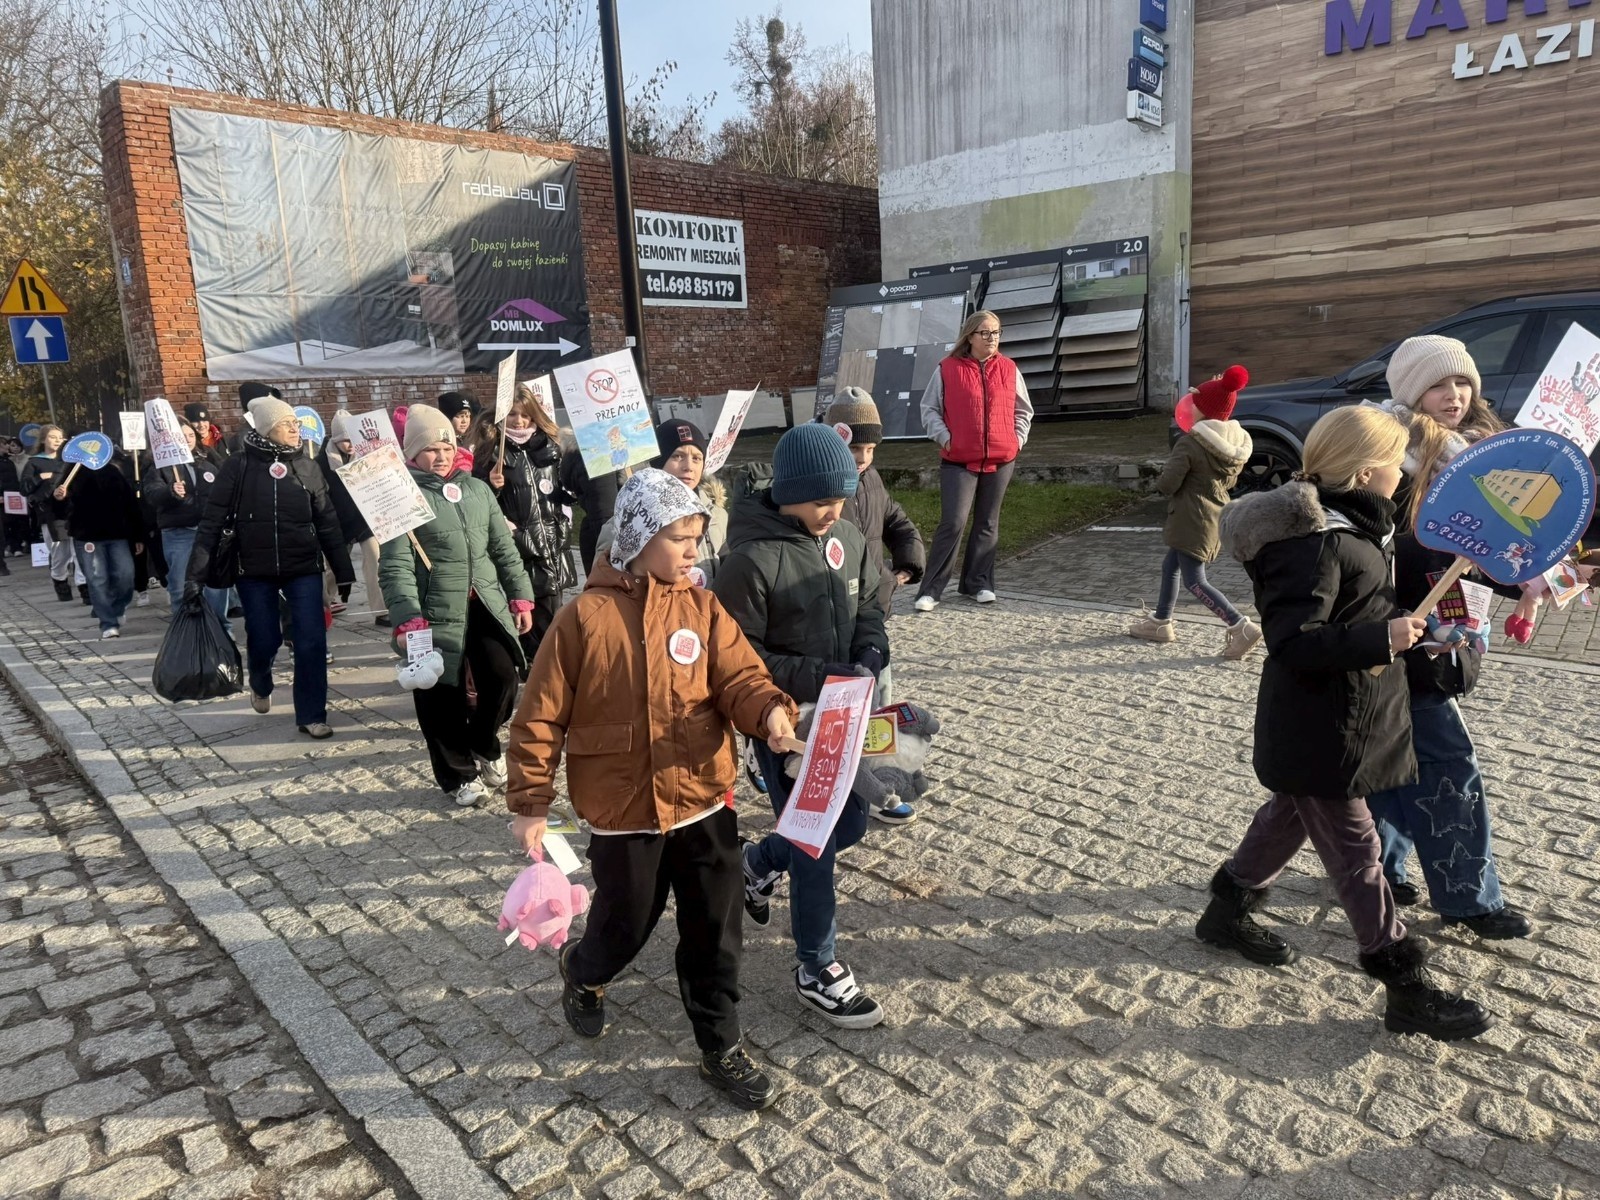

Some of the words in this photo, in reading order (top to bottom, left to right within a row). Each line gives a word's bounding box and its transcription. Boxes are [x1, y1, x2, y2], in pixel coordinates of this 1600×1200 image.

[1142, 35, 1164, 54] GERDA
[1452, 19, 1595, 80] ŁAZI
[462, 176, 541, 209] radaway
[636, 215, 738, 244] KOMFORT
[470, 237, 507, 253] Dopasuj
[510, 238, 540, 251] kabinę
[1123, 240, 1143, 253] 2.0
[492, 254, 503, 268] do
[506, 255, 532, 268] swojej
[535, 252, 568, 266] łazienki
[637, 243, 687, 262] REMONTY
[690, 247, 741, 267] MIESZKAŃ
[694, 277, 715, 296] 851
[715, 280, 735, 297] 179
[889, 284, 917, 293] opoczno
[504, 309, 520, 319] MB
[491, 319, 544, 332] DOMLUX
[592, 377, 613, 392] STOP
[1574, 374, 1600, 399] STOP
[1518, 434, 1532, 443] nr
[1532, 434, 1541, 443] 2
[1545, 437, 1559, 449] im.
[1450, 436, 1516, 474] Podstawowa
[1561, 444, 1590, 496] Władysława
[1427, 472, 1451, 505] Szkoła
[1450, 511, 1469, 526] SP
[1471, 519, 1481, 532] 2
[1546, 497, 1590, 562] Broniewskiego
[1426, 522, 1436, 531] w
[1438, 525, 1490, 557] Pasłęku
[1443, 607, 1464, 618] NIE
